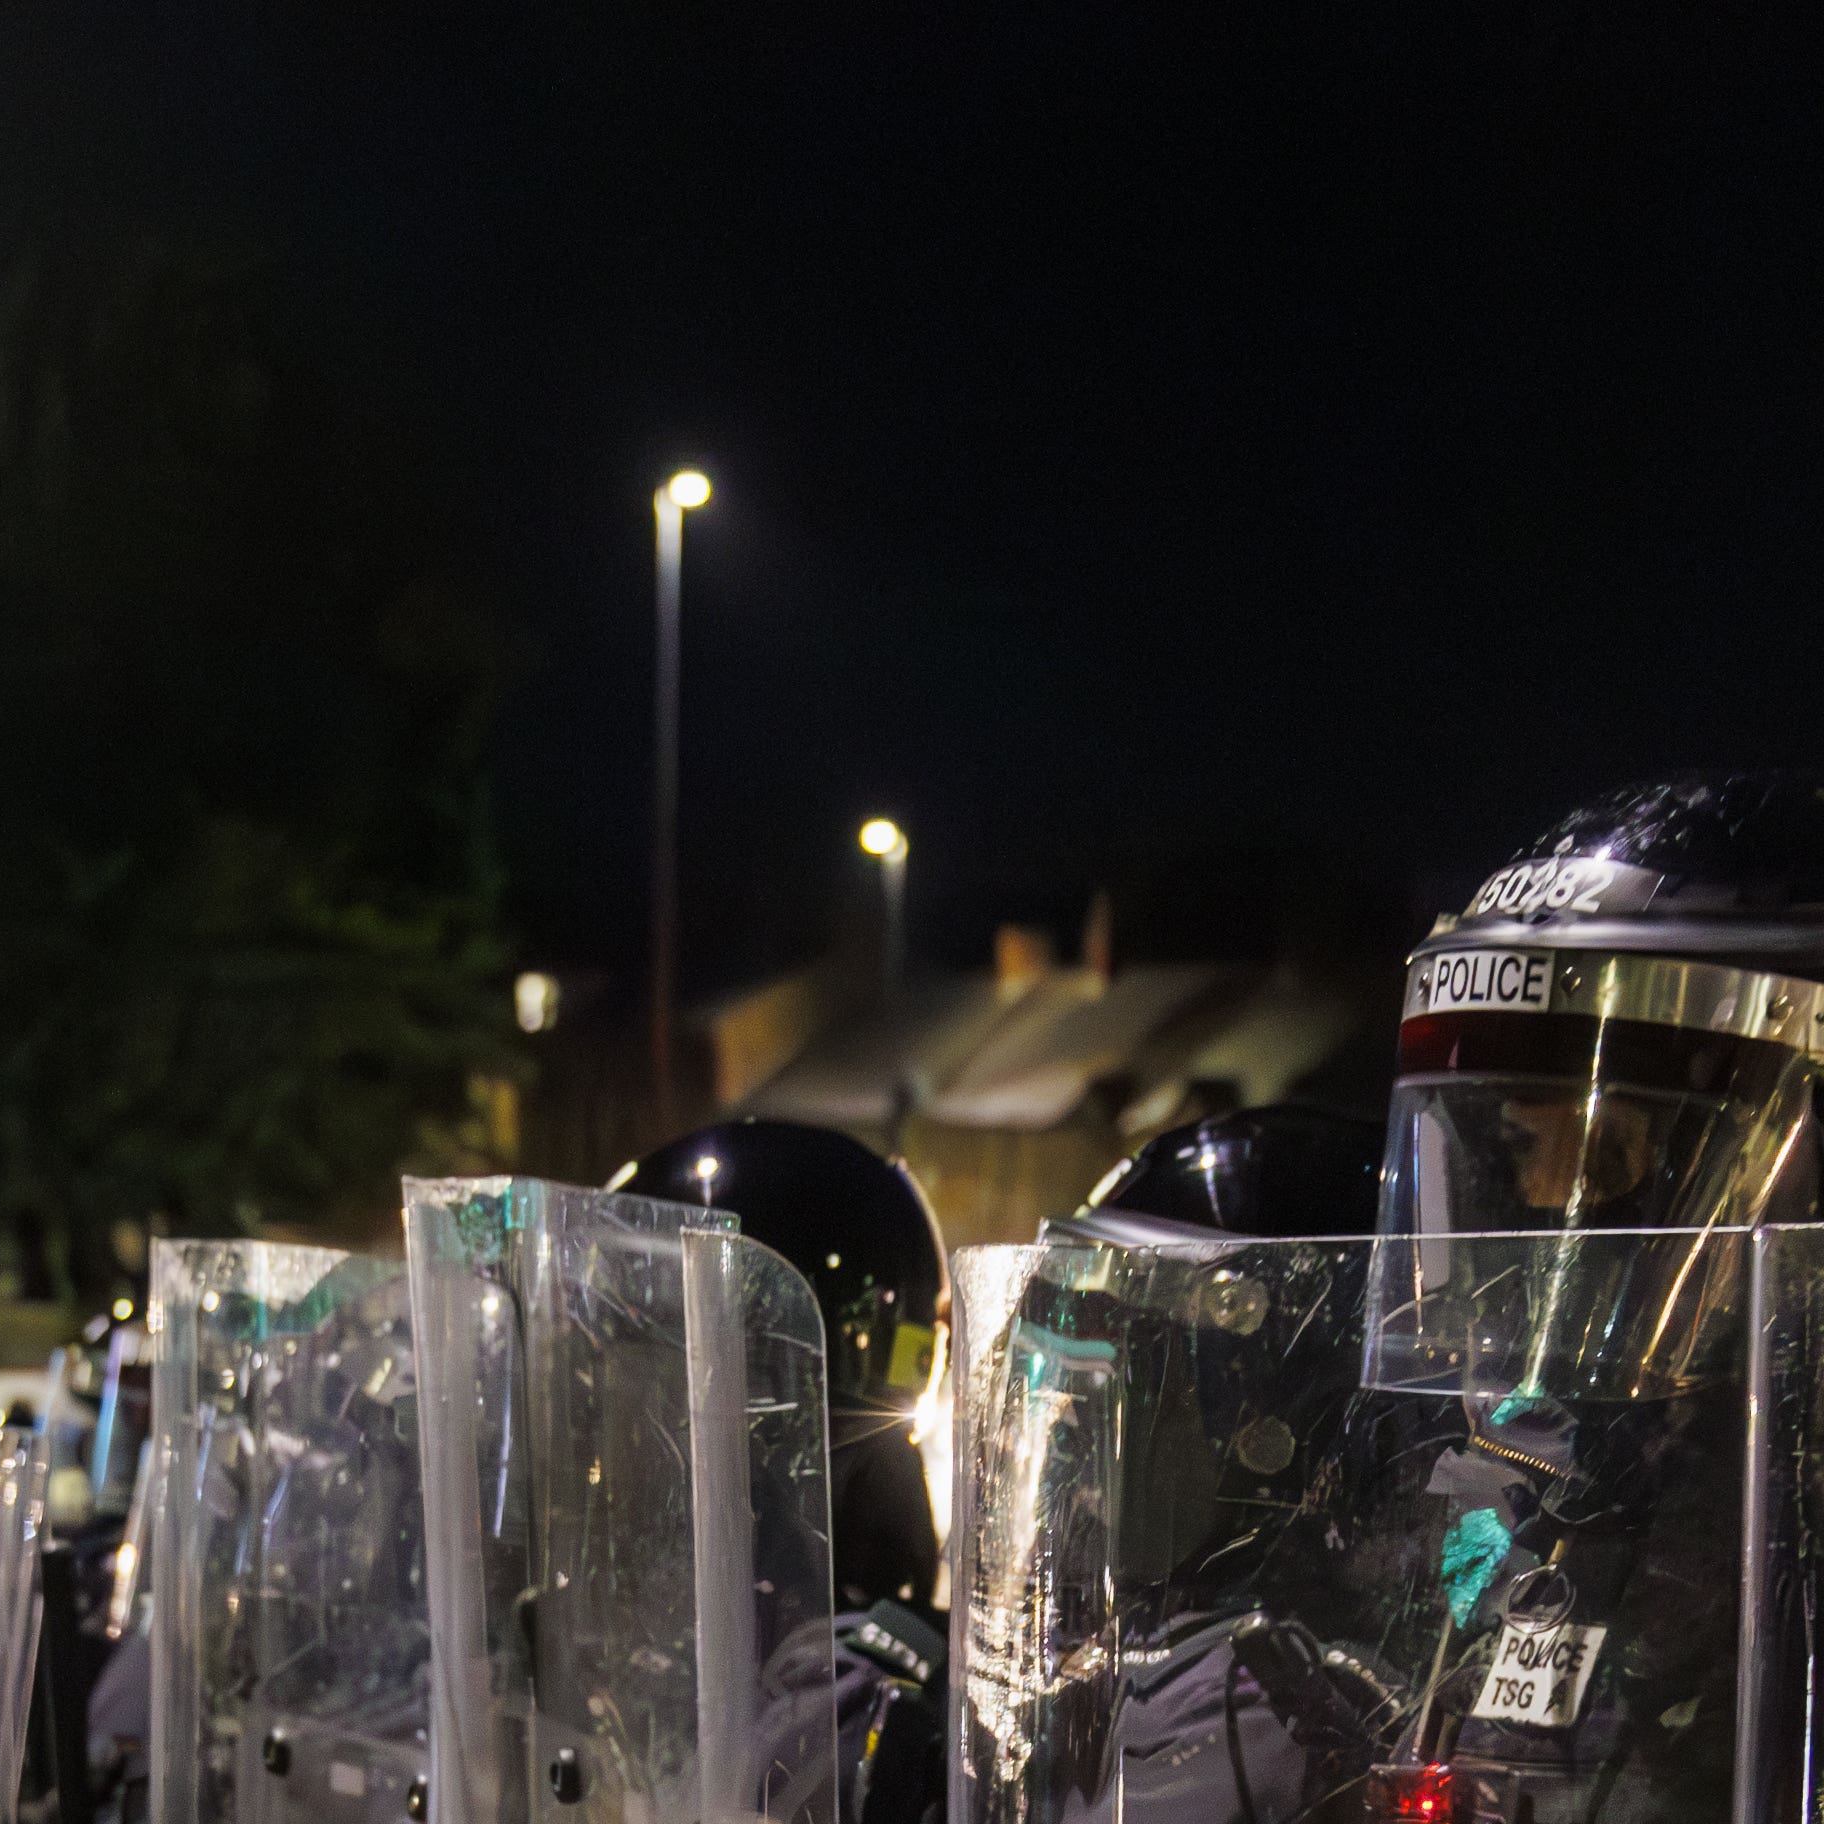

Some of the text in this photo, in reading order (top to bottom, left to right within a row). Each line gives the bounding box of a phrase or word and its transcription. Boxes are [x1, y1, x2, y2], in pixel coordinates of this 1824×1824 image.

[1433, 956, 1549, 1005] POLICE
[1502, 1637, 1588, 1672] POLICE
[1491, 1677, 1535, 1709] TSG
